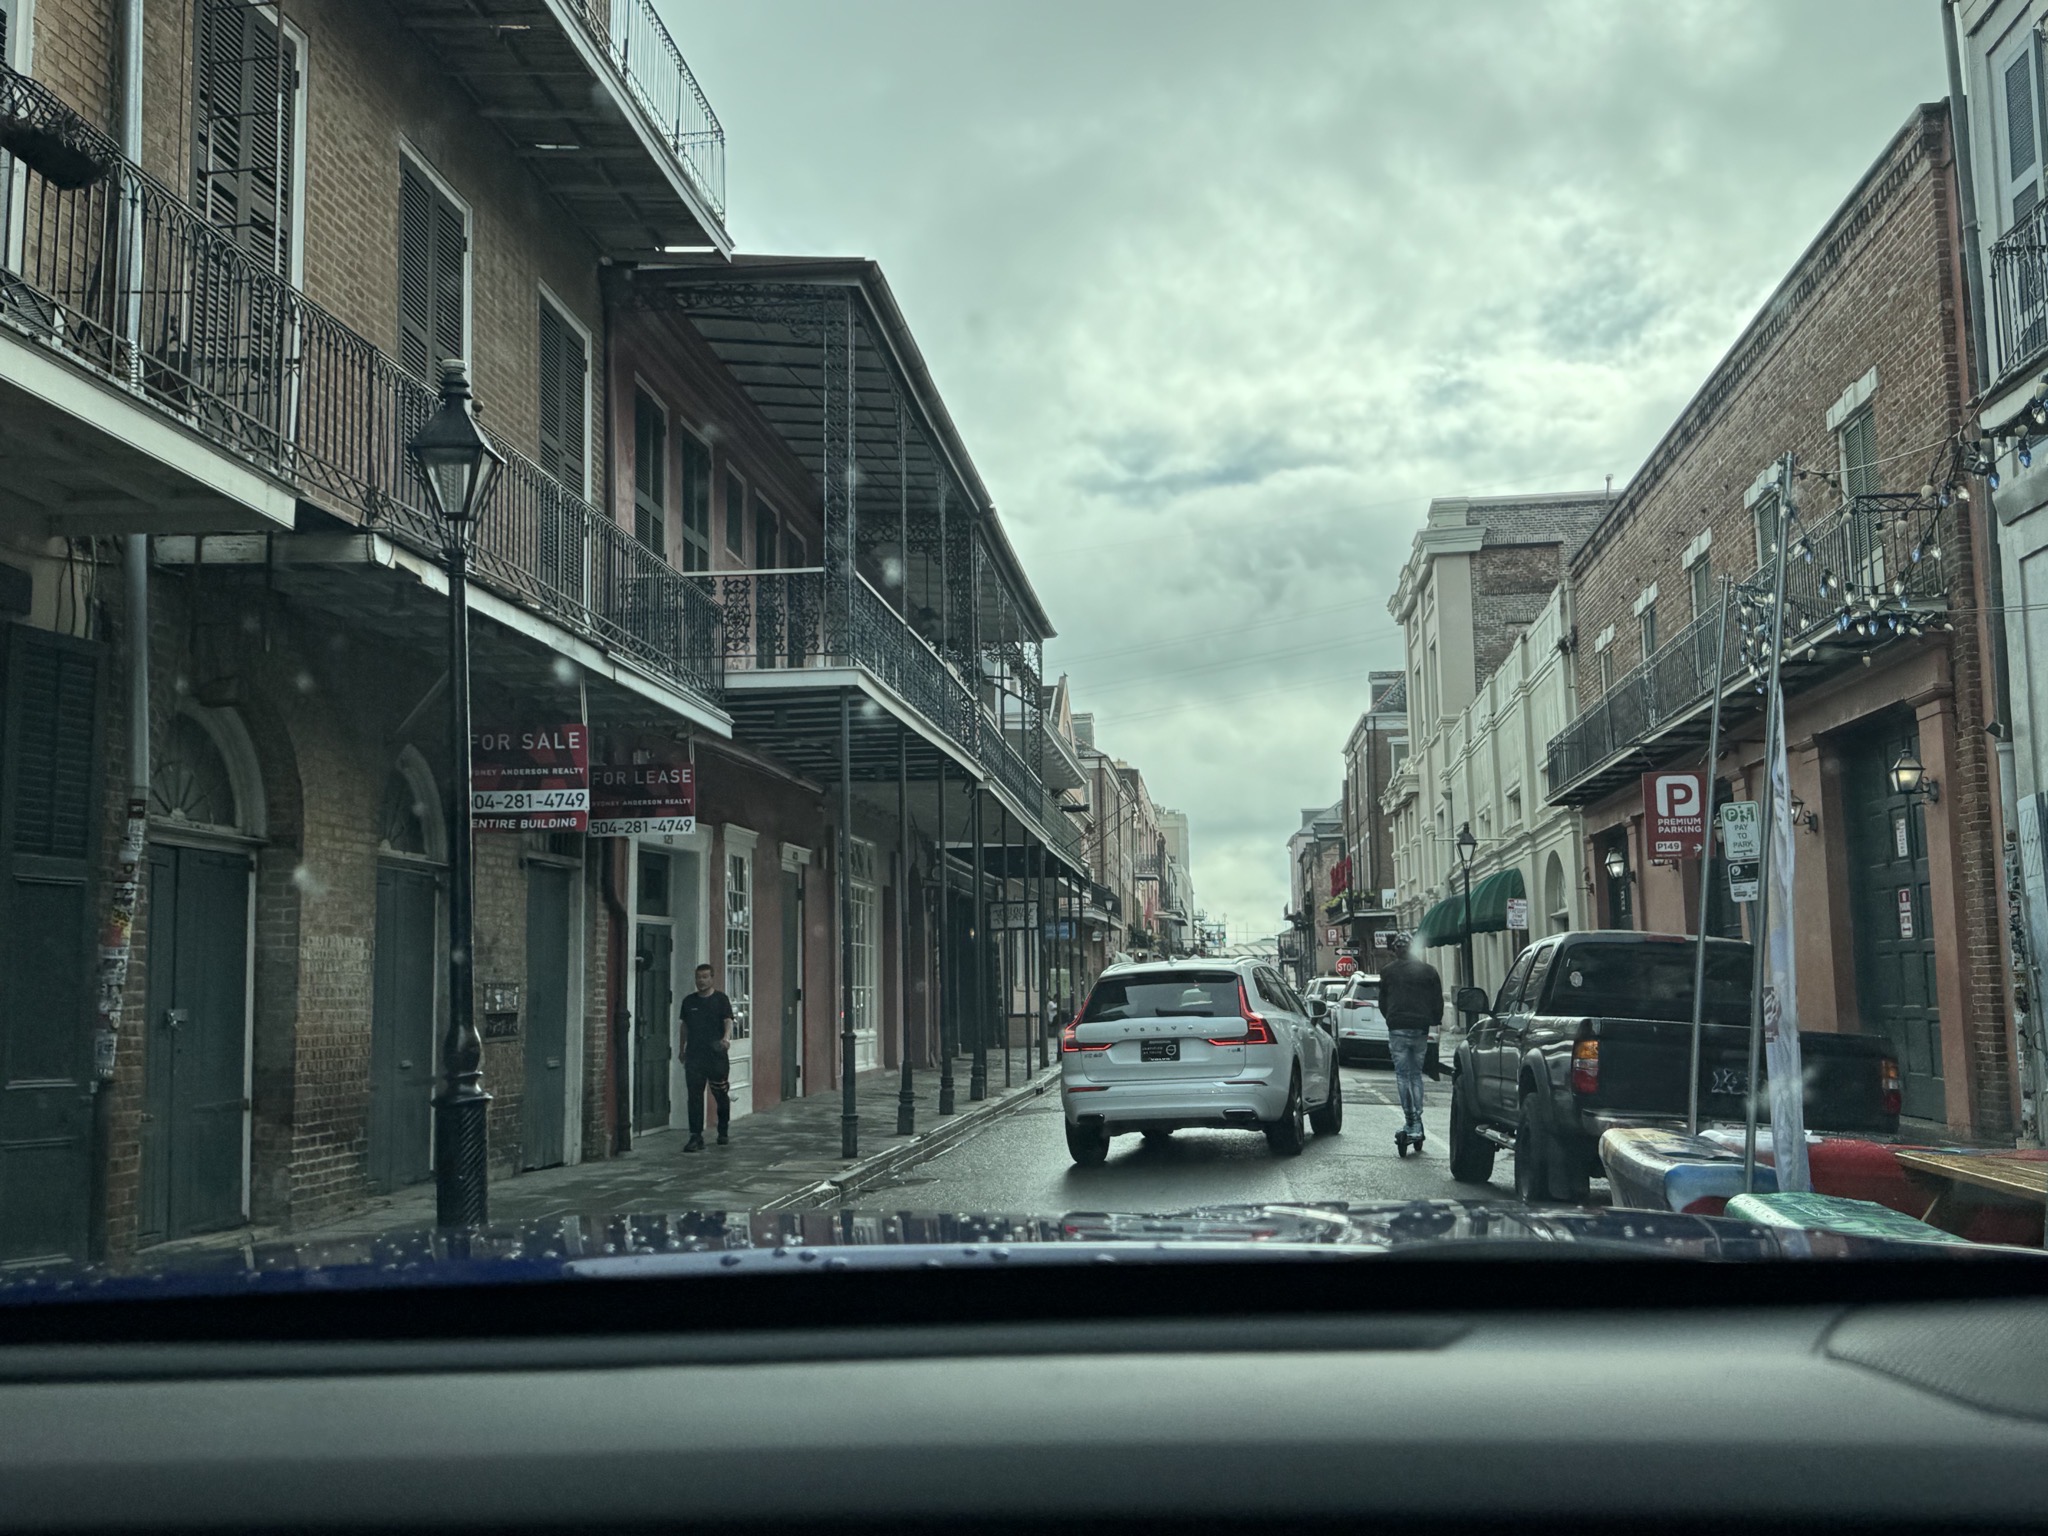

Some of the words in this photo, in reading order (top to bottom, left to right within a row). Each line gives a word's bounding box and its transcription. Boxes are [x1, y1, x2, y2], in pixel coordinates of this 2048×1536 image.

[522, 732, 580, 750] SALE
[501, 768, 549, 776] ANDERSON
[552, 767, 584, 775] REALTY
[592, 771, 626, 785] FOR
[634, 769, 691, 785] LEASE
[472, 792, 585, 809] 04-281-4749
[520, 817, 577, 829] BUILDING
[1657, 817, 1702, 826] PREMIUM
[591, 819, 692, 834] 504-281-4749
[1657, 825, 1702, 834] PARKING
[1657, 842, 1680, 851] P149
[1733, 841, 1754, 849] PARK
[1337, 963, 1357, 972] STOP
